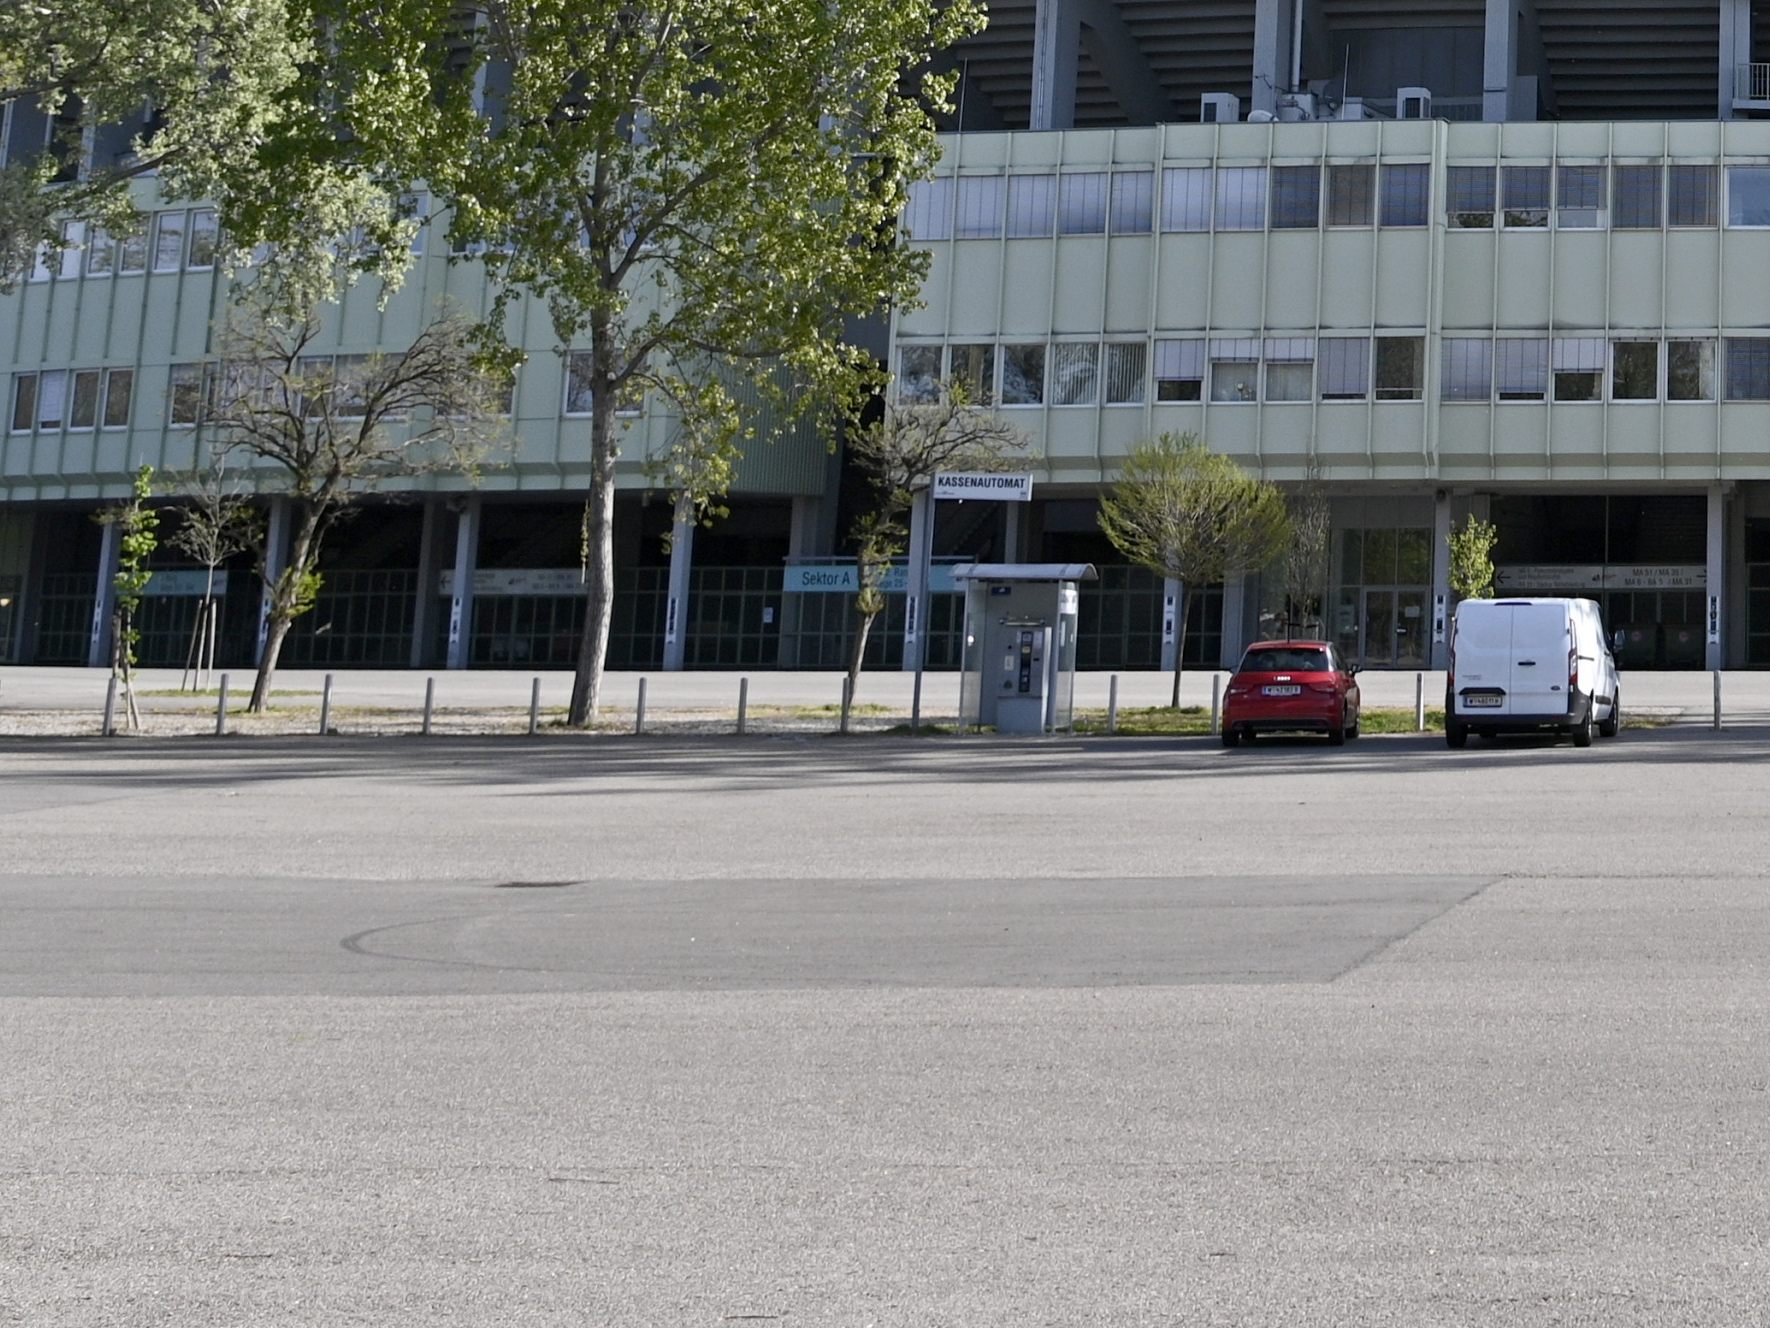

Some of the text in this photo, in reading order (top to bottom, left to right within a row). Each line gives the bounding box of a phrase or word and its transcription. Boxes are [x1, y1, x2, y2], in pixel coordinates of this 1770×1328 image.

[938, 476, 1025, 488] KASSENAUTOMAT
[802, 571, 850, 586] Sektor A
